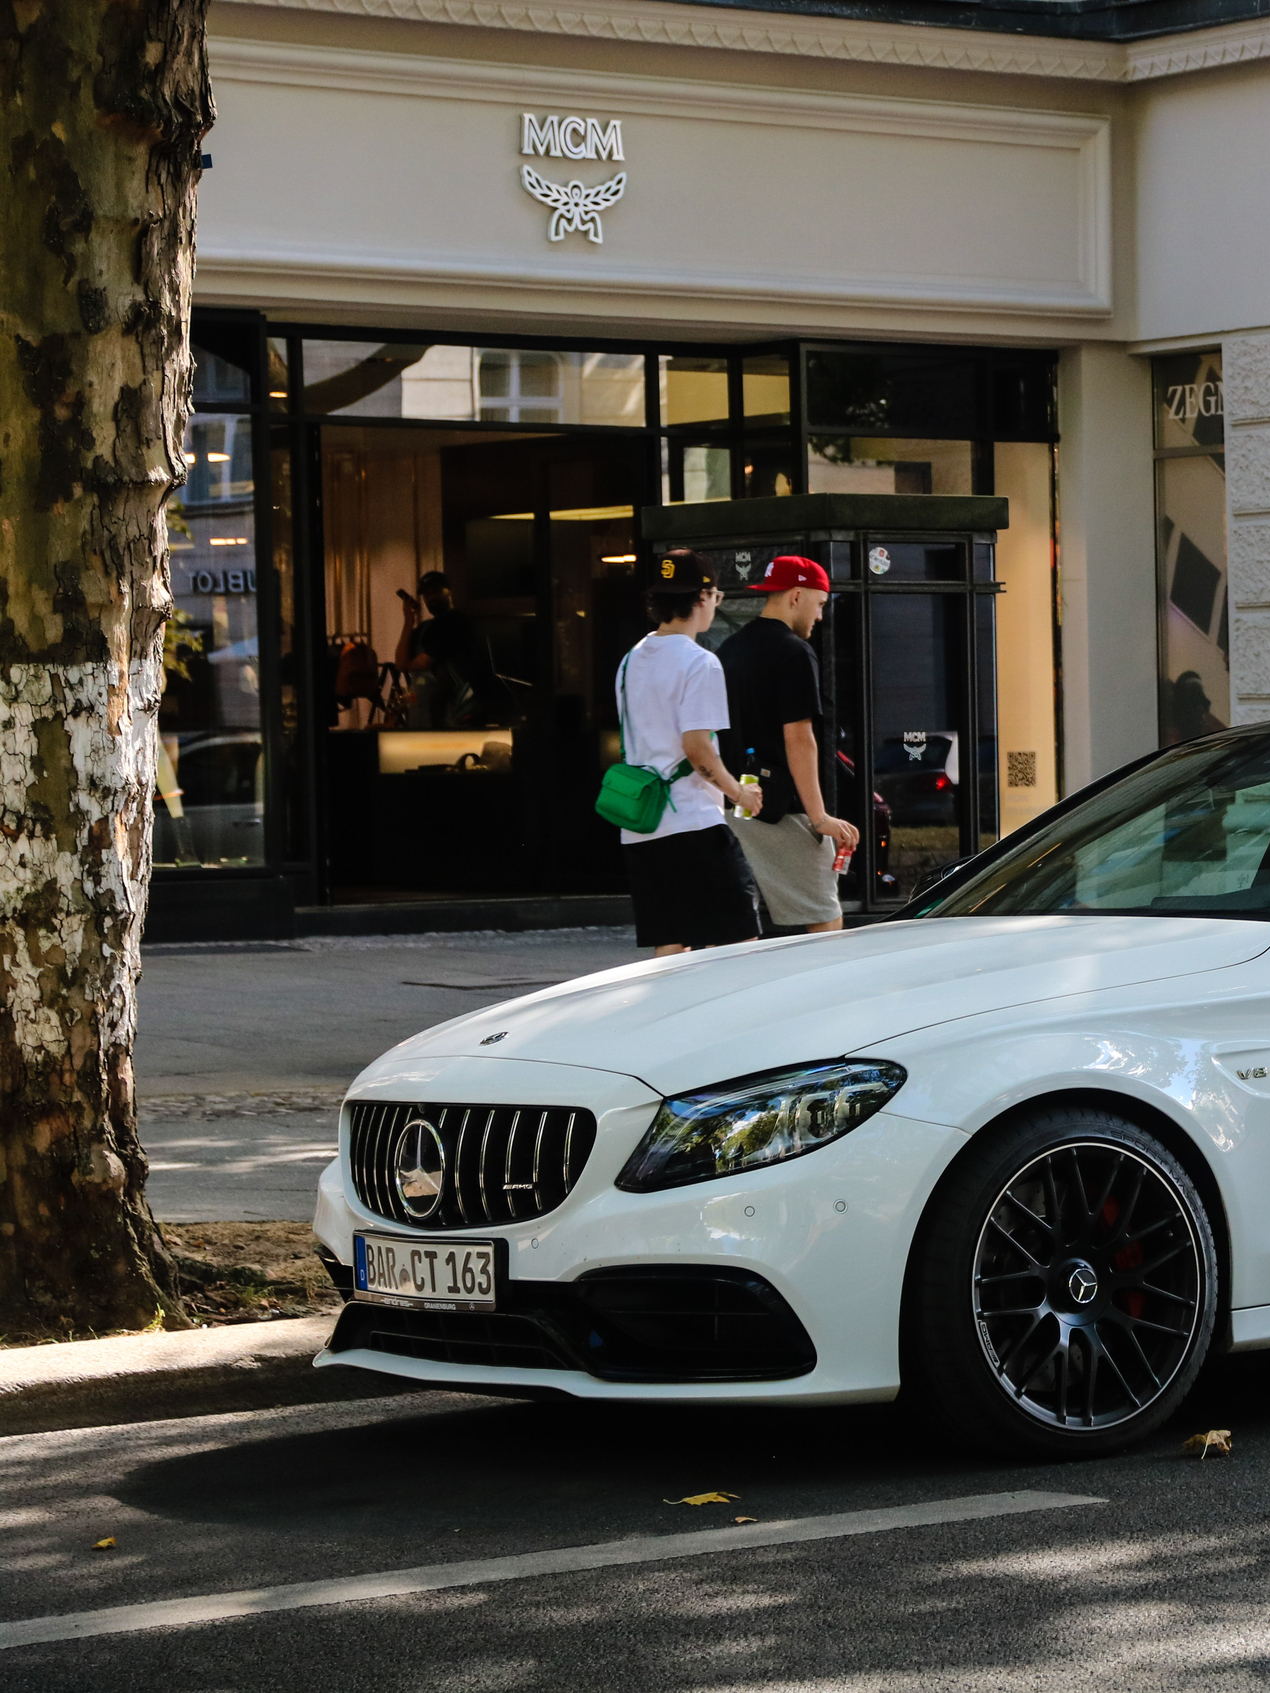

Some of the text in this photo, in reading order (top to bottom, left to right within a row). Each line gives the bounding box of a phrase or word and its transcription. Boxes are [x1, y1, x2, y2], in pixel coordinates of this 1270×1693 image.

[521, 112, 625, 161] MCM
[735, 551, 751, 563] MCM
[903, 731, 927, 743] MCM
[1237, 1066, 1268, 1080] V8
[366, 1244, 399, 1290] BAR
[410, 1249, 438, 1293] CT
[444, 1251, 492, 1296] 163
